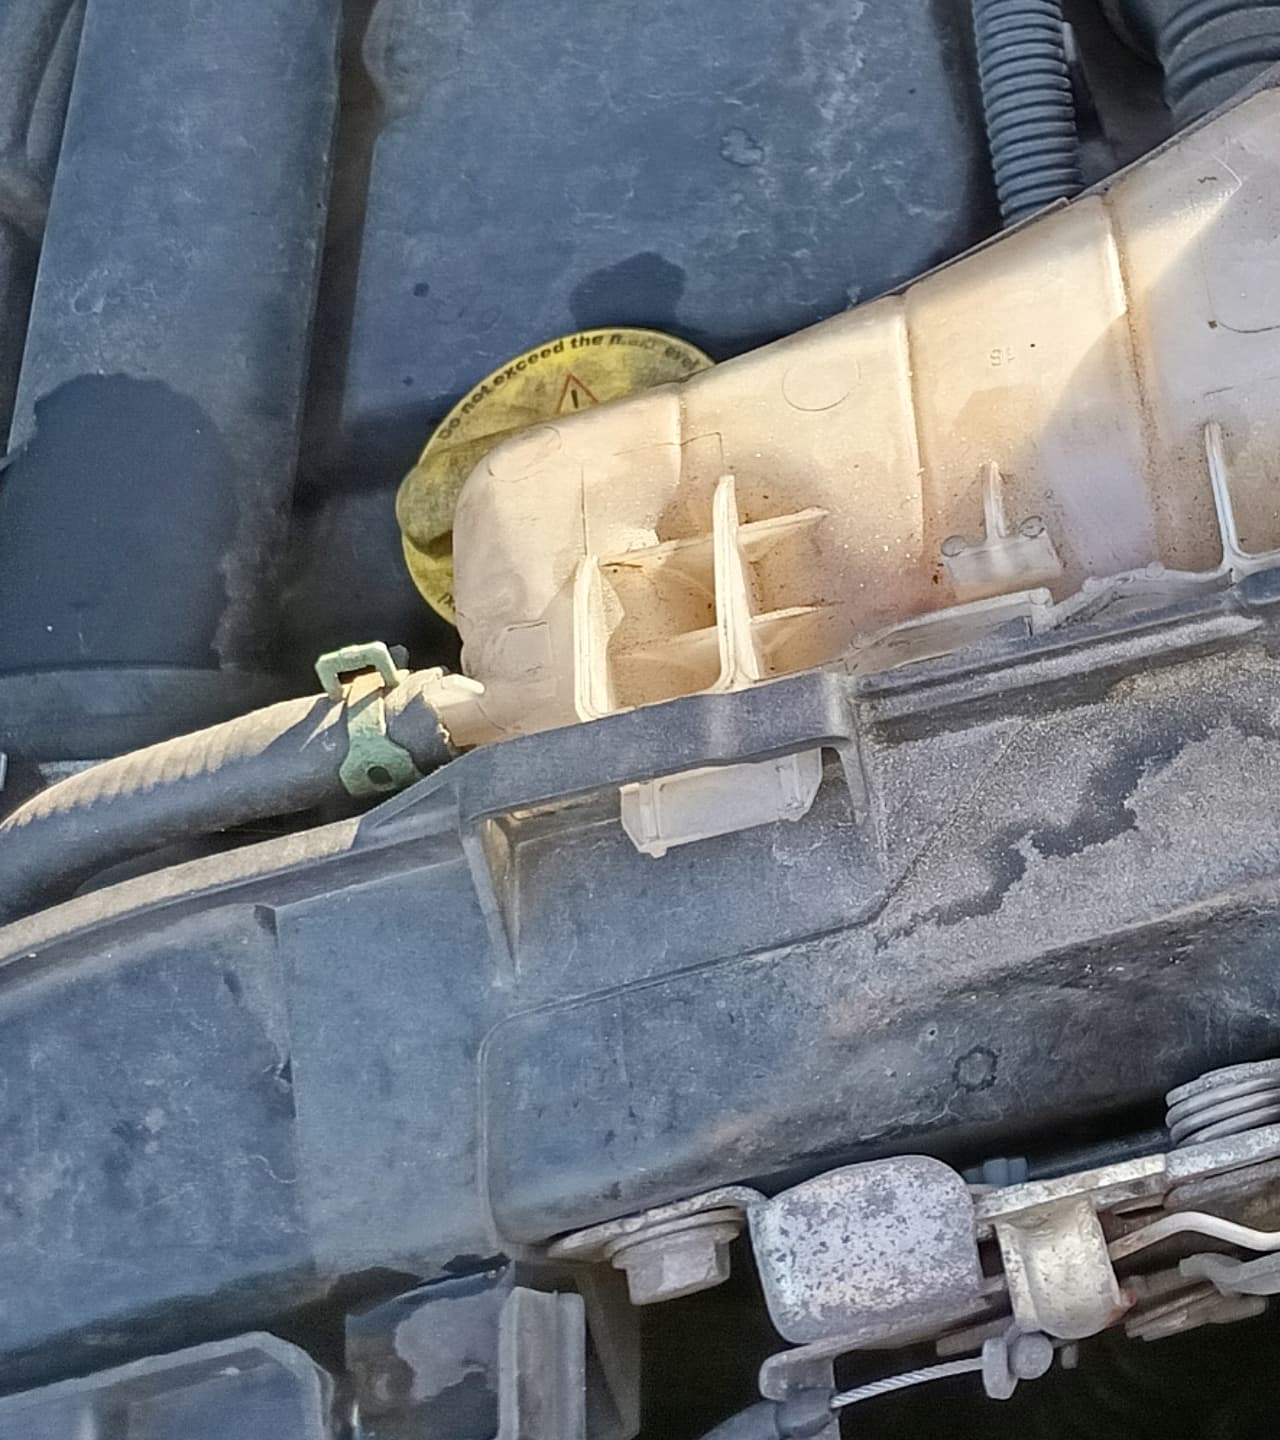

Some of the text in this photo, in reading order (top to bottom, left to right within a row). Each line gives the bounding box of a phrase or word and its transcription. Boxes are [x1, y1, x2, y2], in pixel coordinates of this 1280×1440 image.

[460, 385, 491, 414] not
[493, 340, 565, 387] exceed
[570, 333, 604, 350] the
